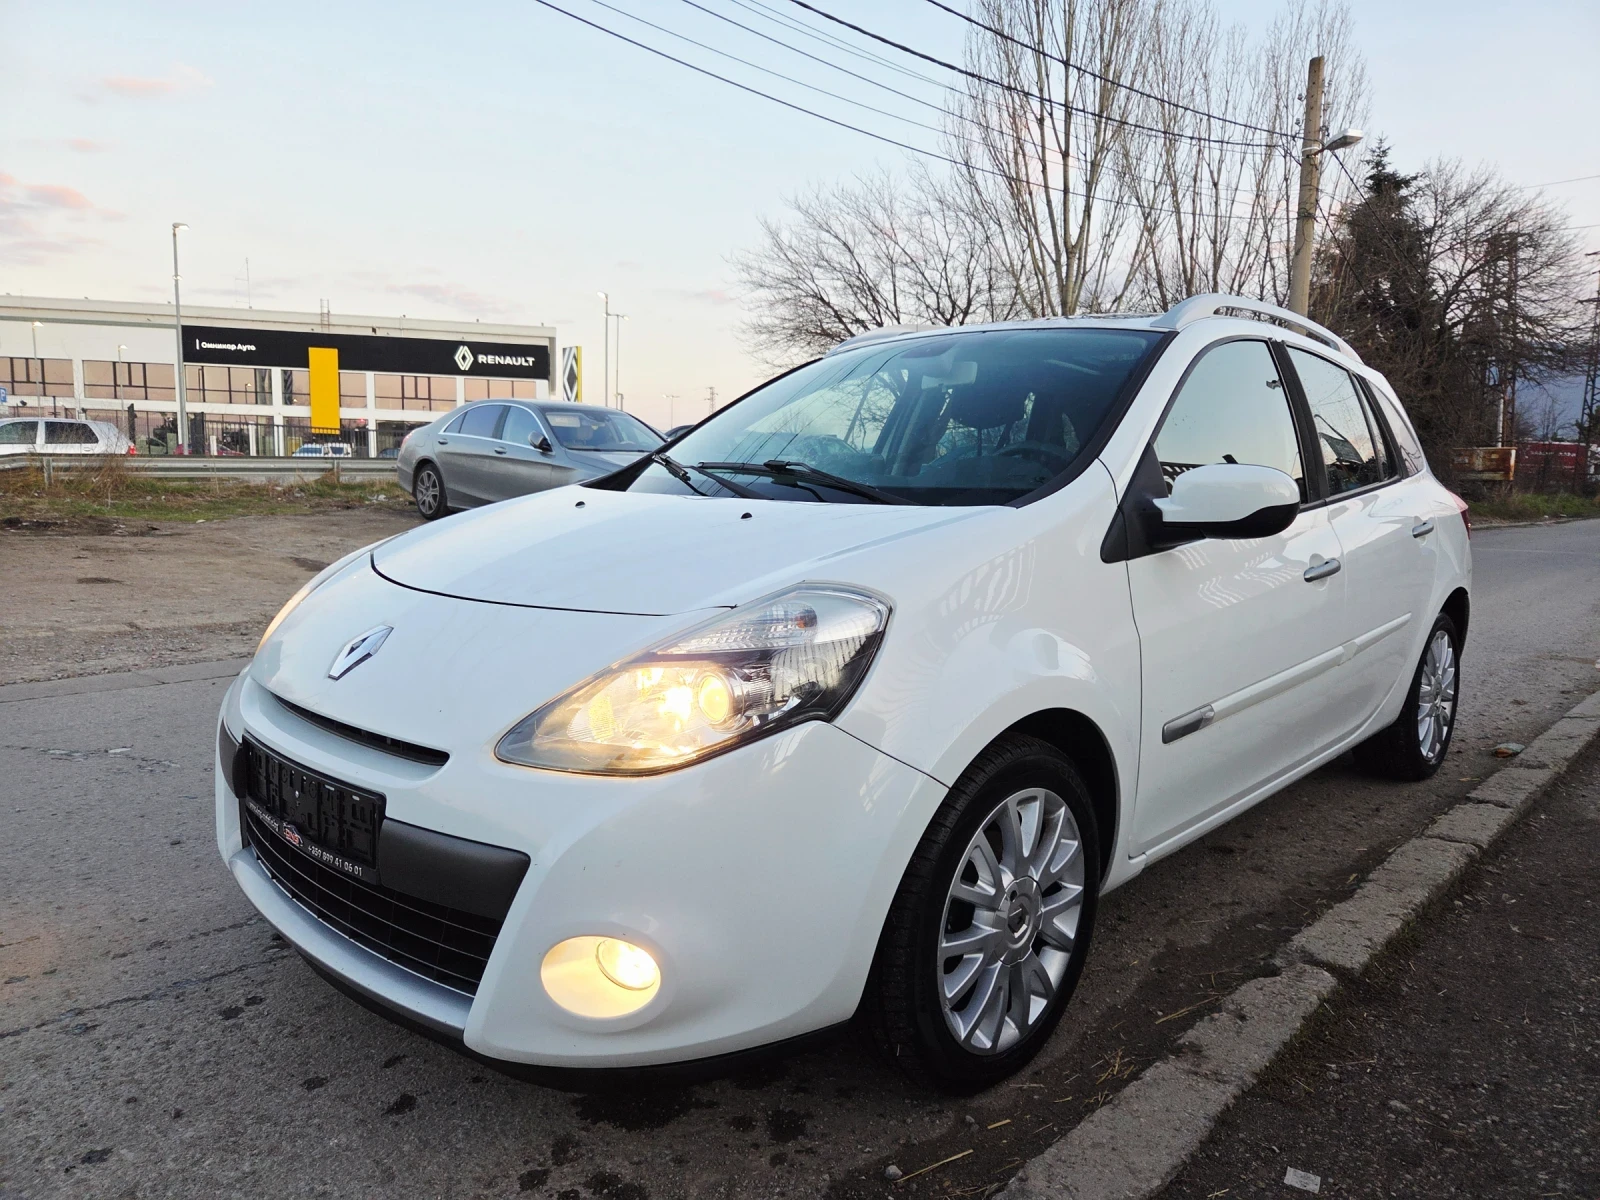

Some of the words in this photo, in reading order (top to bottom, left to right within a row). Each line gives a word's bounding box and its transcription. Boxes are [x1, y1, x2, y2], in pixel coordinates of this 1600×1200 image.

[236, 343, 256, 352] Ауто
[477, 354, 535, 366] RENAULT
[322, 851, 334, 864] 899
[334, 857, 342, 868] 41
[344, 861, 353, 873] 06
[354, 865, 362, 876] 01
